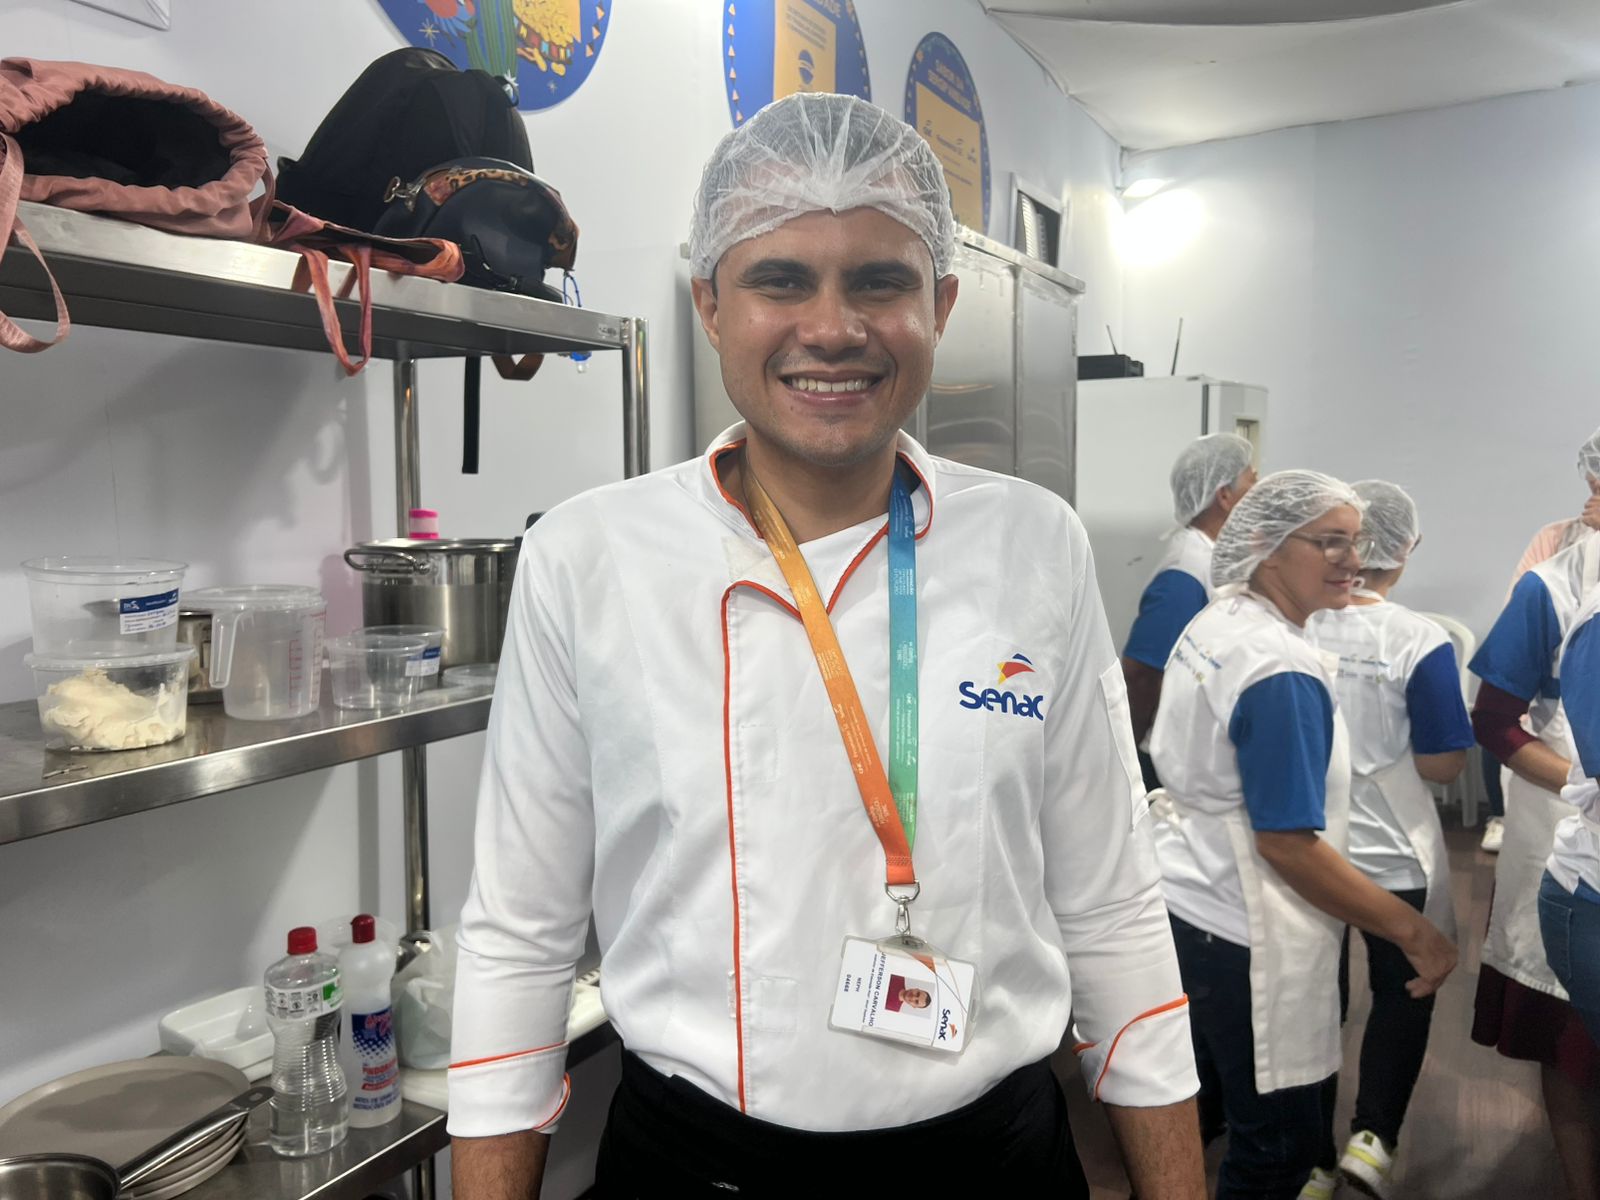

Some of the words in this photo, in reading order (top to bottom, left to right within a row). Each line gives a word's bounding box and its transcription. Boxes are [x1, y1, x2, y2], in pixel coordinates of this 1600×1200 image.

[958, 681, 1044, 721] Senac
[874, 951, 887, 990] JEFFERSON
[868, 991, 880, 1027] CARVALHO
[938, 1008, 951, 1041] Senac
